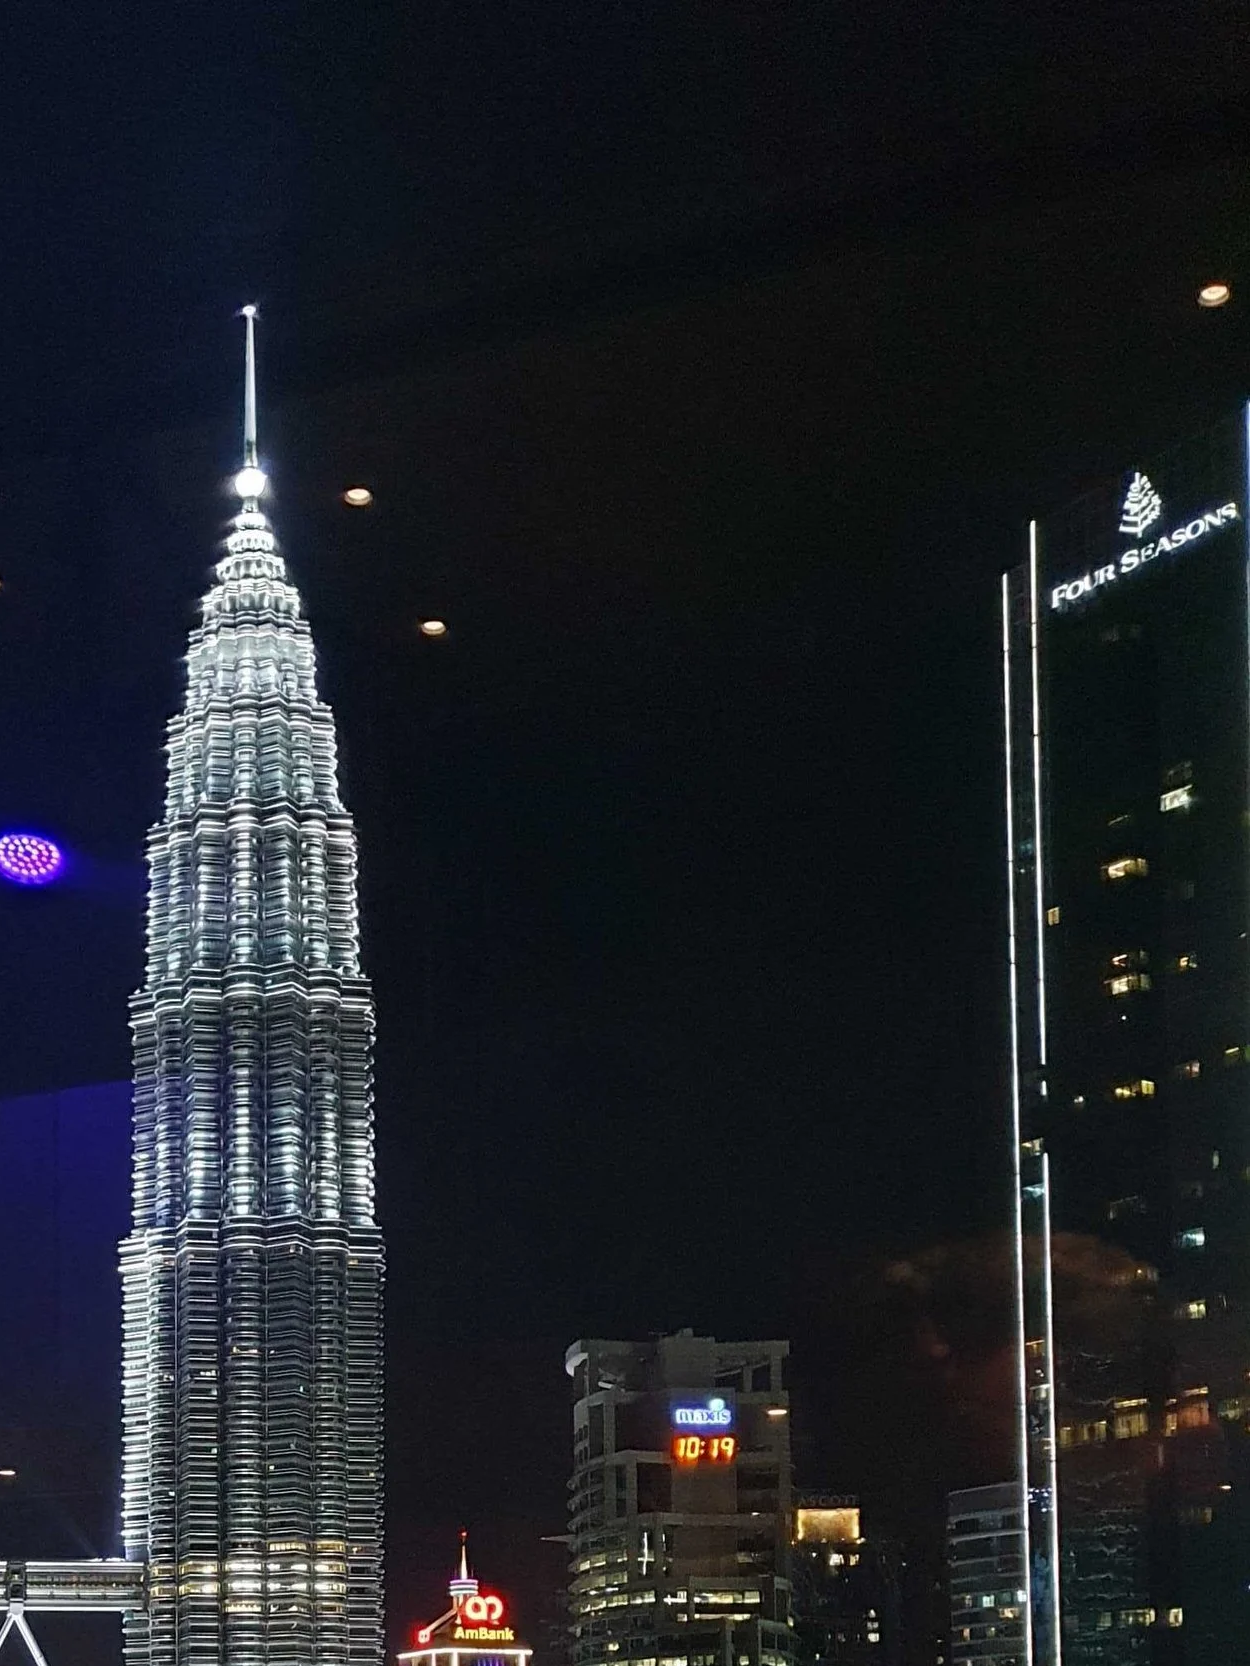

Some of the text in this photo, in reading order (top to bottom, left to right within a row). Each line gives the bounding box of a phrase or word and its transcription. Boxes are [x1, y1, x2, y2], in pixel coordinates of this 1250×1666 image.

[1051, 502, 1238, 609] FOUR SEASONS
[675, 1398, 732, 1425] maxis
[677, 1436, 735, 1459] 10:19
[454, 1624, 515, 1641] AmBank
